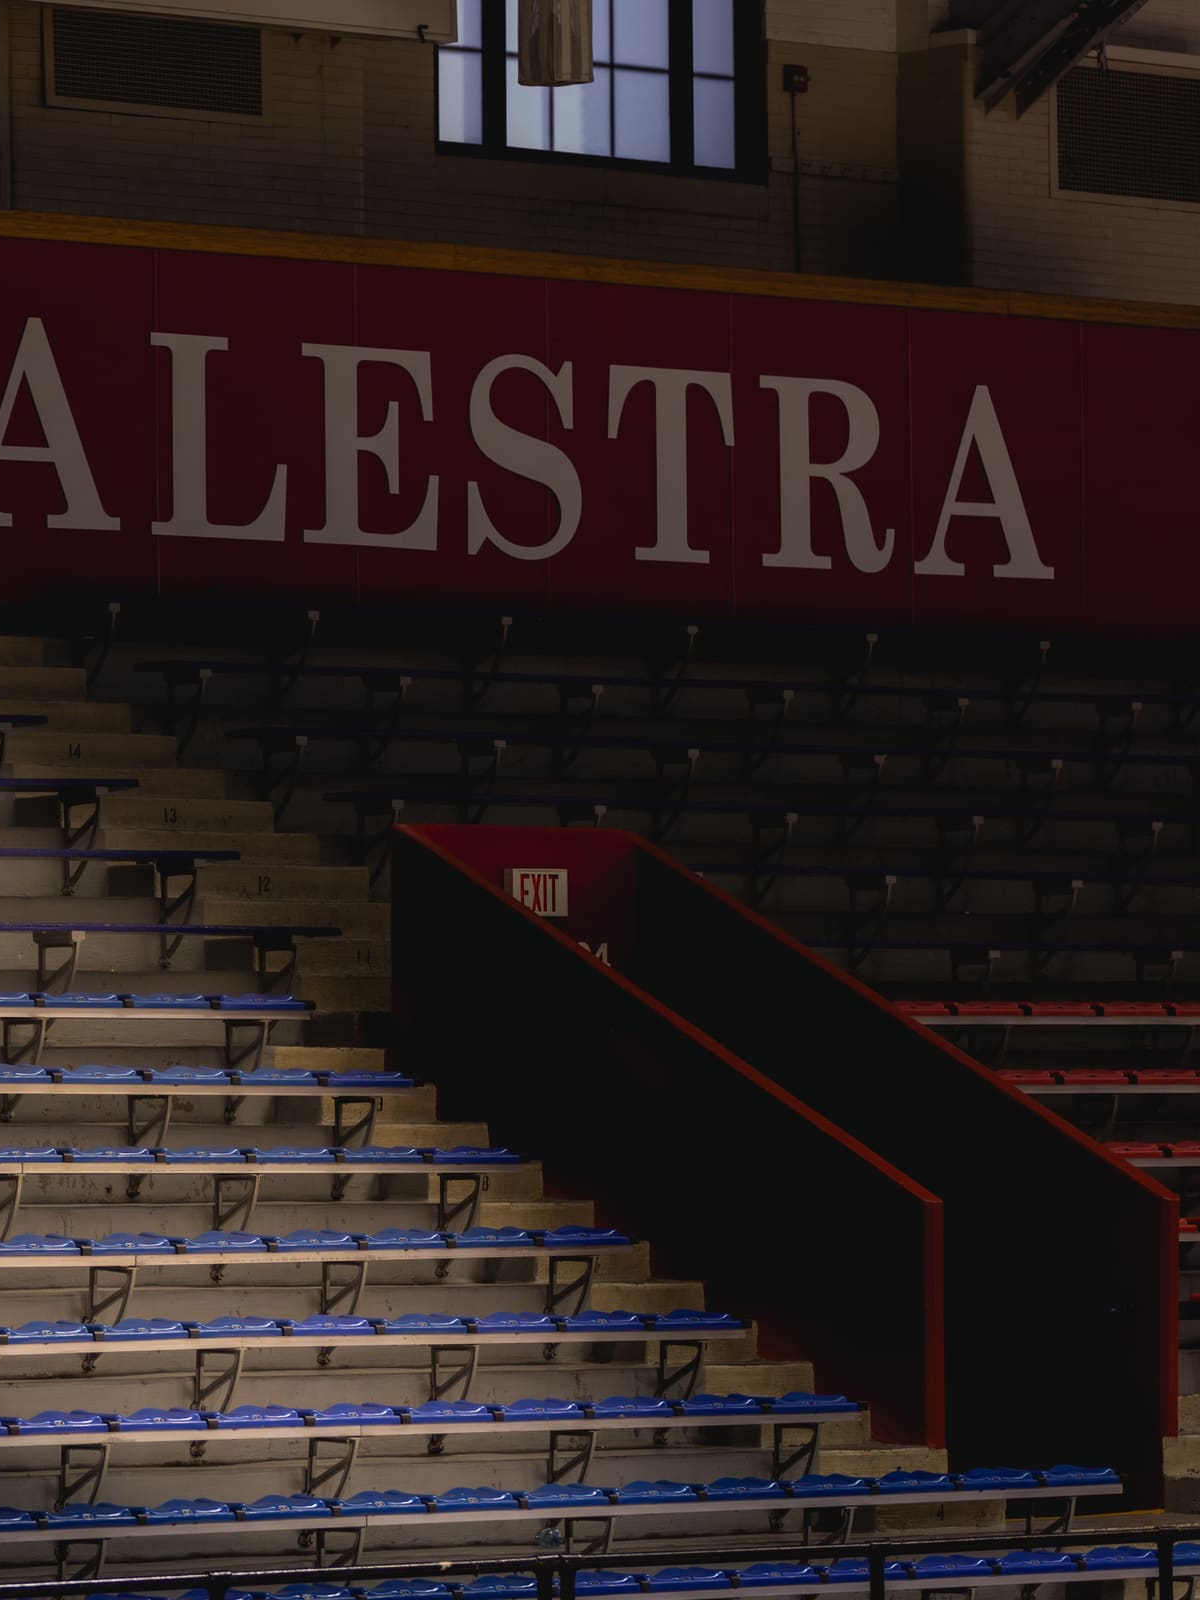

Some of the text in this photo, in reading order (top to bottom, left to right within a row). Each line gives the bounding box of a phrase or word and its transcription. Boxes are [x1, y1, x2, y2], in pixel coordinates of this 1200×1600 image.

[164, 807, 178, 823] 13
[257, 875, 272, 893] 12
[519, 873, 559, 913] EXIT
